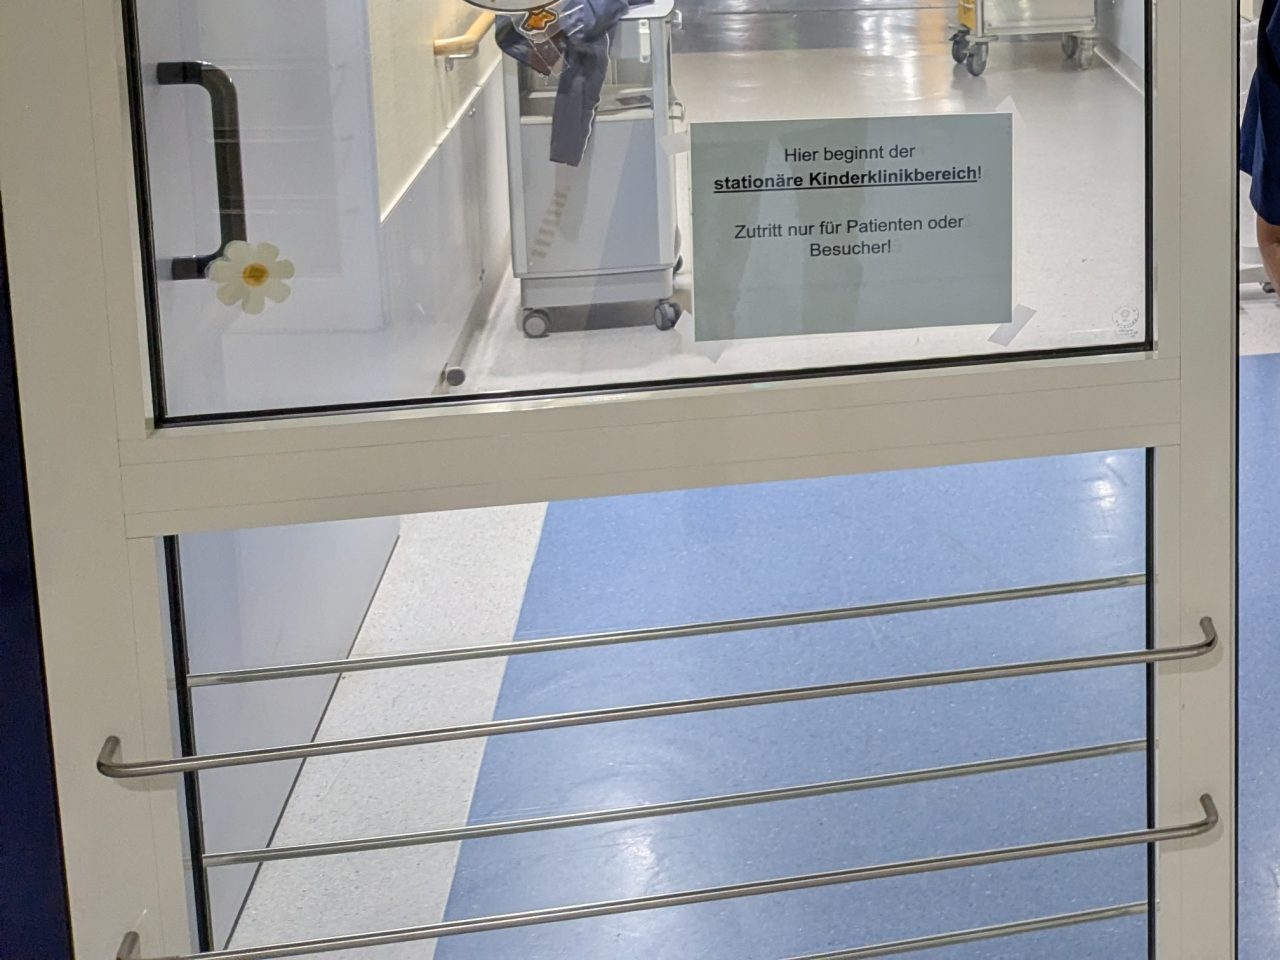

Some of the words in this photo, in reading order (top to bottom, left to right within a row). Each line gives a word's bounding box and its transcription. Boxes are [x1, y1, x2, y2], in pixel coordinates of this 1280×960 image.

[785, 148, 819, 162] Hier
[824, 146, 884, 163] beginnt
[889, 145, 915, 158] der
[713, 174, 804, 193] stationäre
[808, 166, 981, 190] Kinderklinikbereich!
[735, 224, 782, 239] Zutritt
[788, 225, 815, 236] nur
[819, 221, 842, 234] für
[847, 218, 922, 233] Patienten
[928, 216, 964, 229] oder
[810, 240, 891, 256] Besucher!
